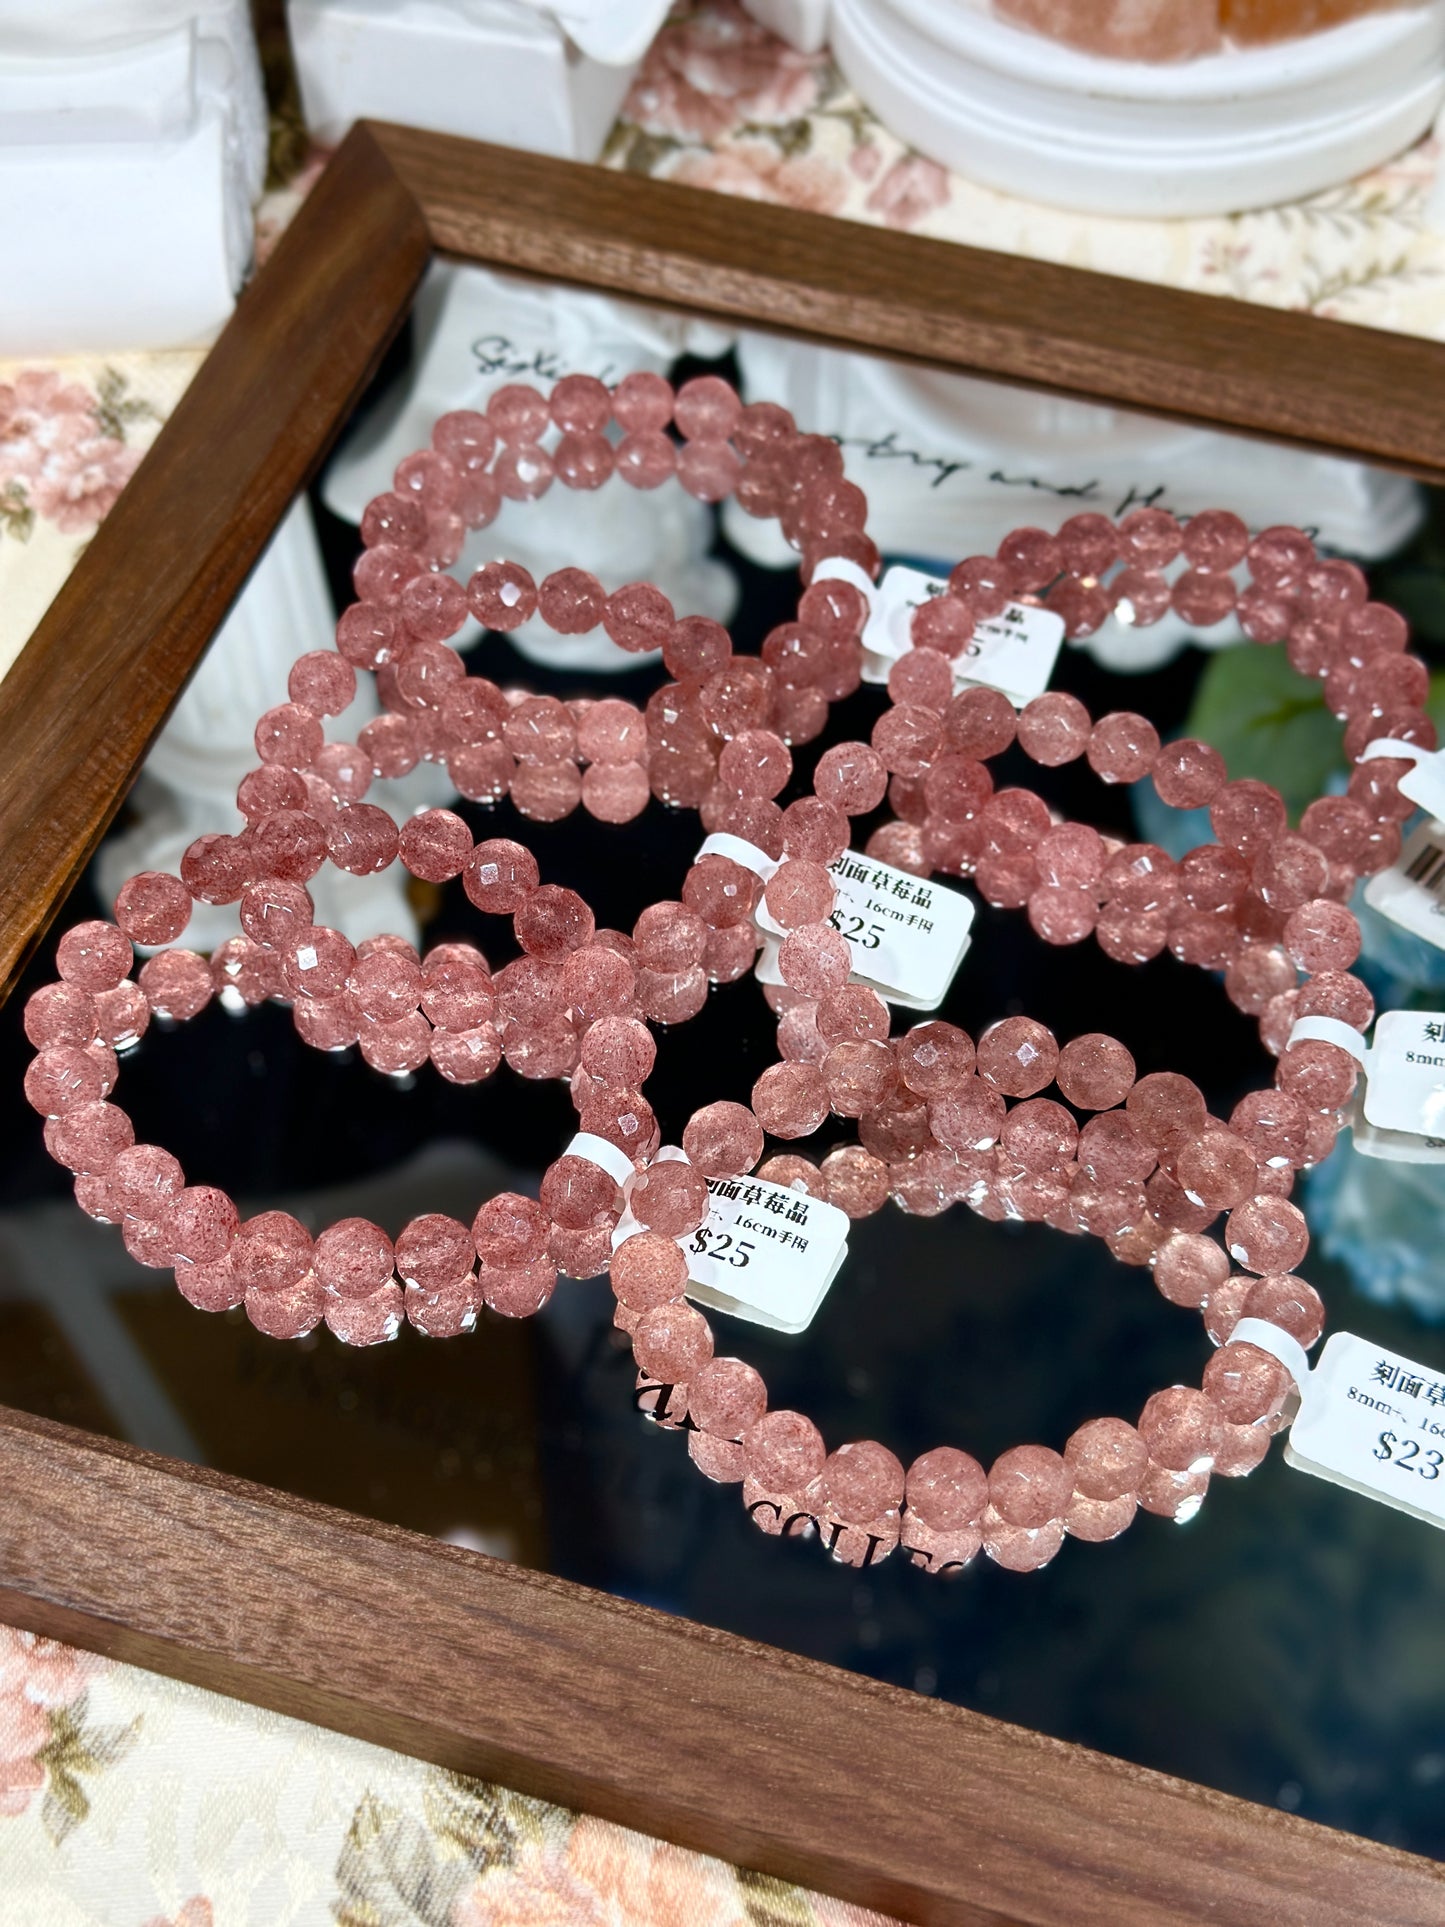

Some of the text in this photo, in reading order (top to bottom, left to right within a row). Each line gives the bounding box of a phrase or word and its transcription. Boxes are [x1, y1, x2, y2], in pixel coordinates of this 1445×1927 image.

[827, 908, 885, 949] $25
[689, 1226, 756, 1268] $25
[1372, 1429, 1444, 1480] $23
